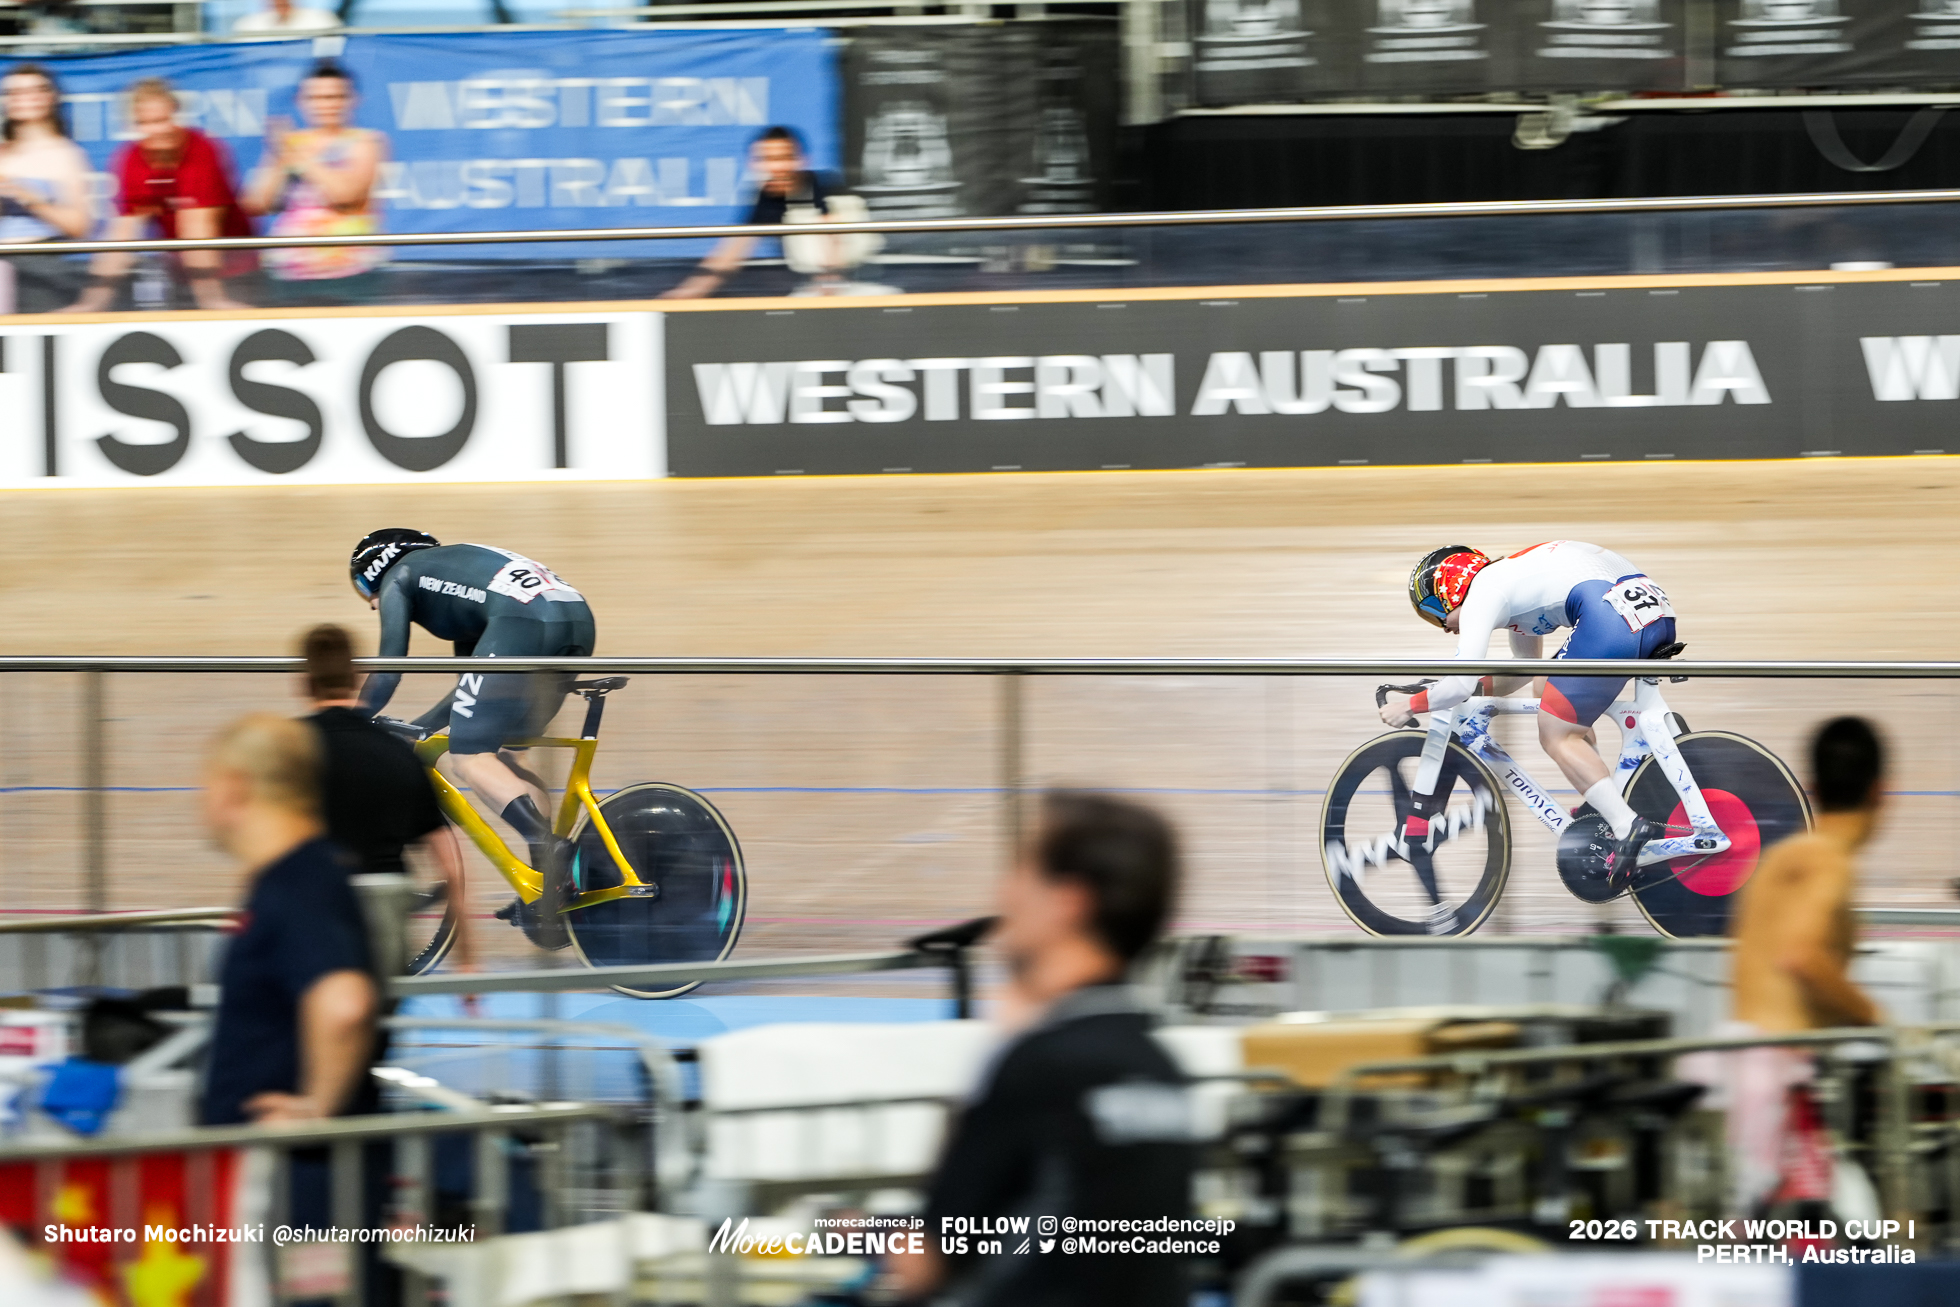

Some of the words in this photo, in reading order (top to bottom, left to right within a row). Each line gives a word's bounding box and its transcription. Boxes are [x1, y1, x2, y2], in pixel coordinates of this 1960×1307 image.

[387, 76, 770, 131] WESTERN
[0, 324, 608, 477] ISSOT
[692, 352, 1176, 425] WESTERN
[1190, 340, 1773, 415] AUSTRALIA
[418, 575, 445, 593] NEW
[442, 581, 487, 604] ZEALAND
[508, 568, 543, 589] 40
[1454, 555, 1483, 593] JAPAN
[1623, 586, 1660, 611] 37
[1504, 768, 1564, 827] TORAYCA
